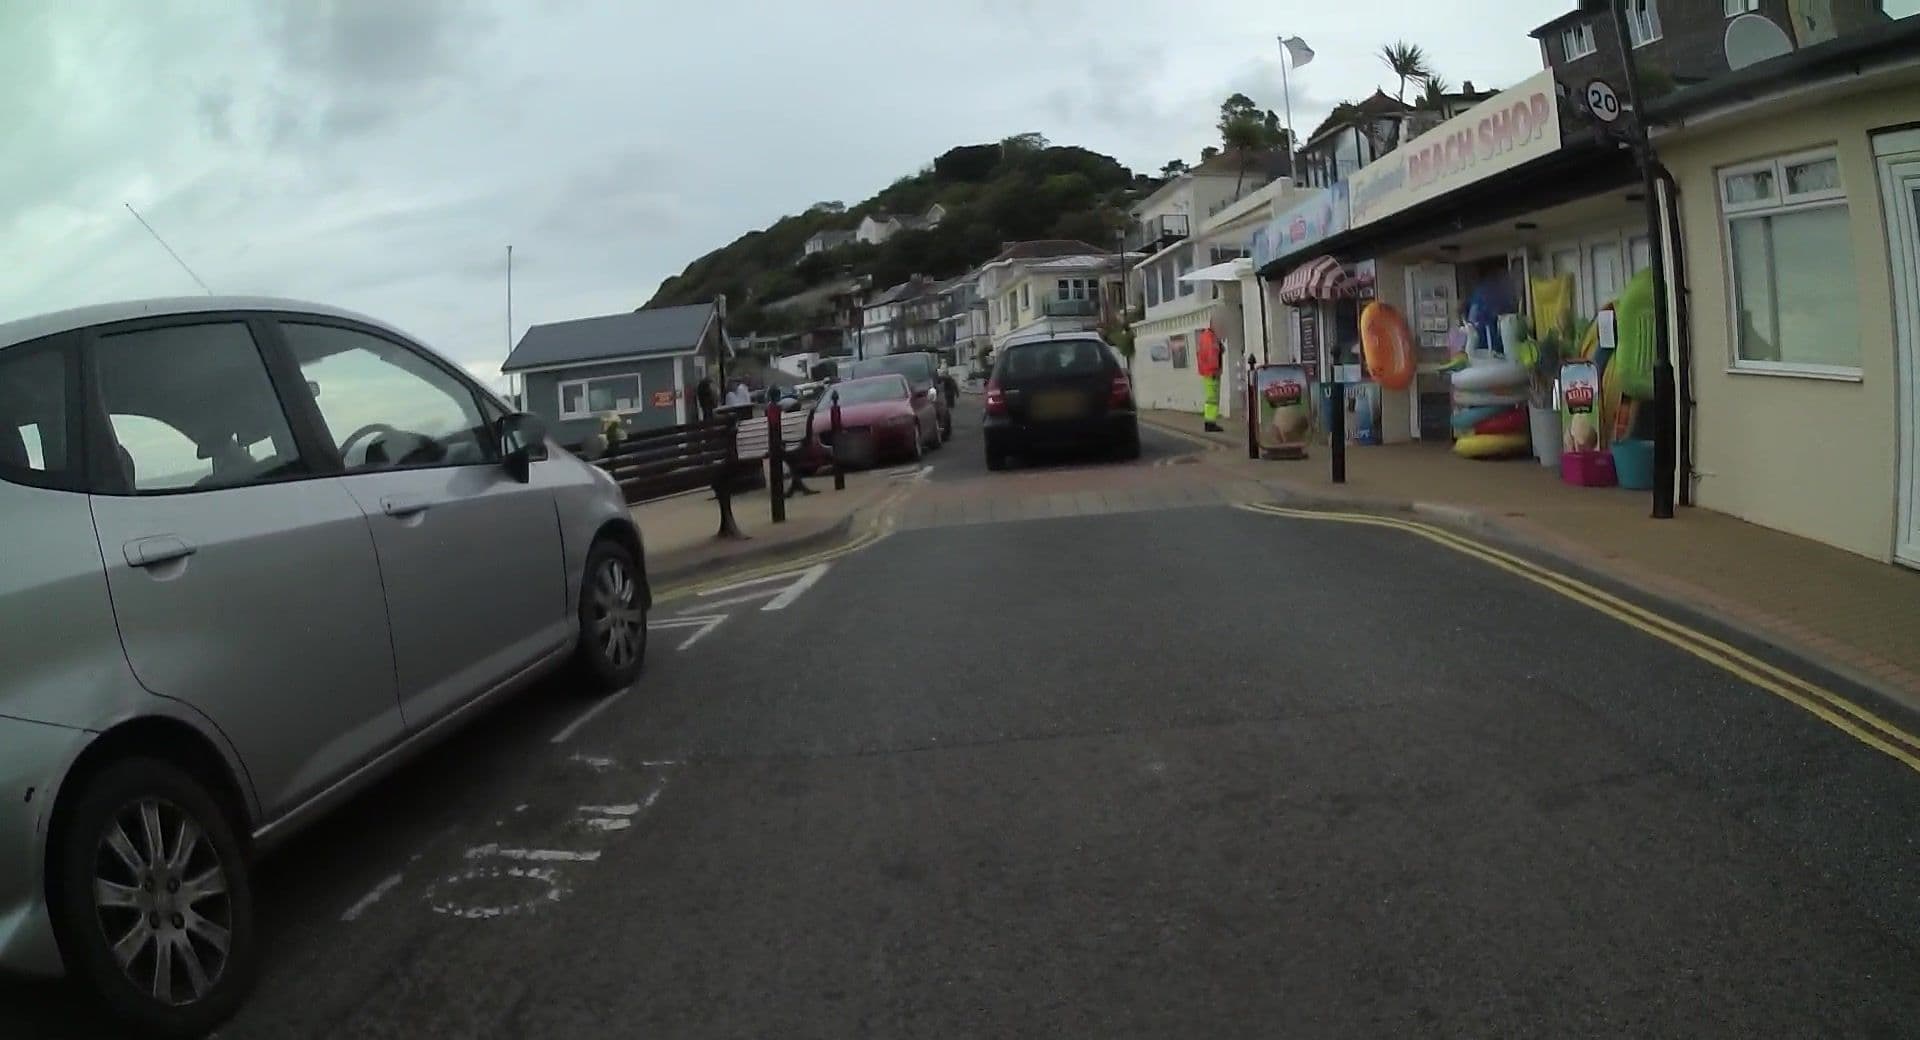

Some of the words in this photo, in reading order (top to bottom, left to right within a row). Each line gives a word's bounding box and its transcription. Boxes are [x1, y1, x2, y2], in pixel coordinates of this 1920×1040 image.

[1591, 89, 1617, 113] 20
[1408, 126, 1476, 192] BEACH
[1478, 92, 1551, 161] SHOP
